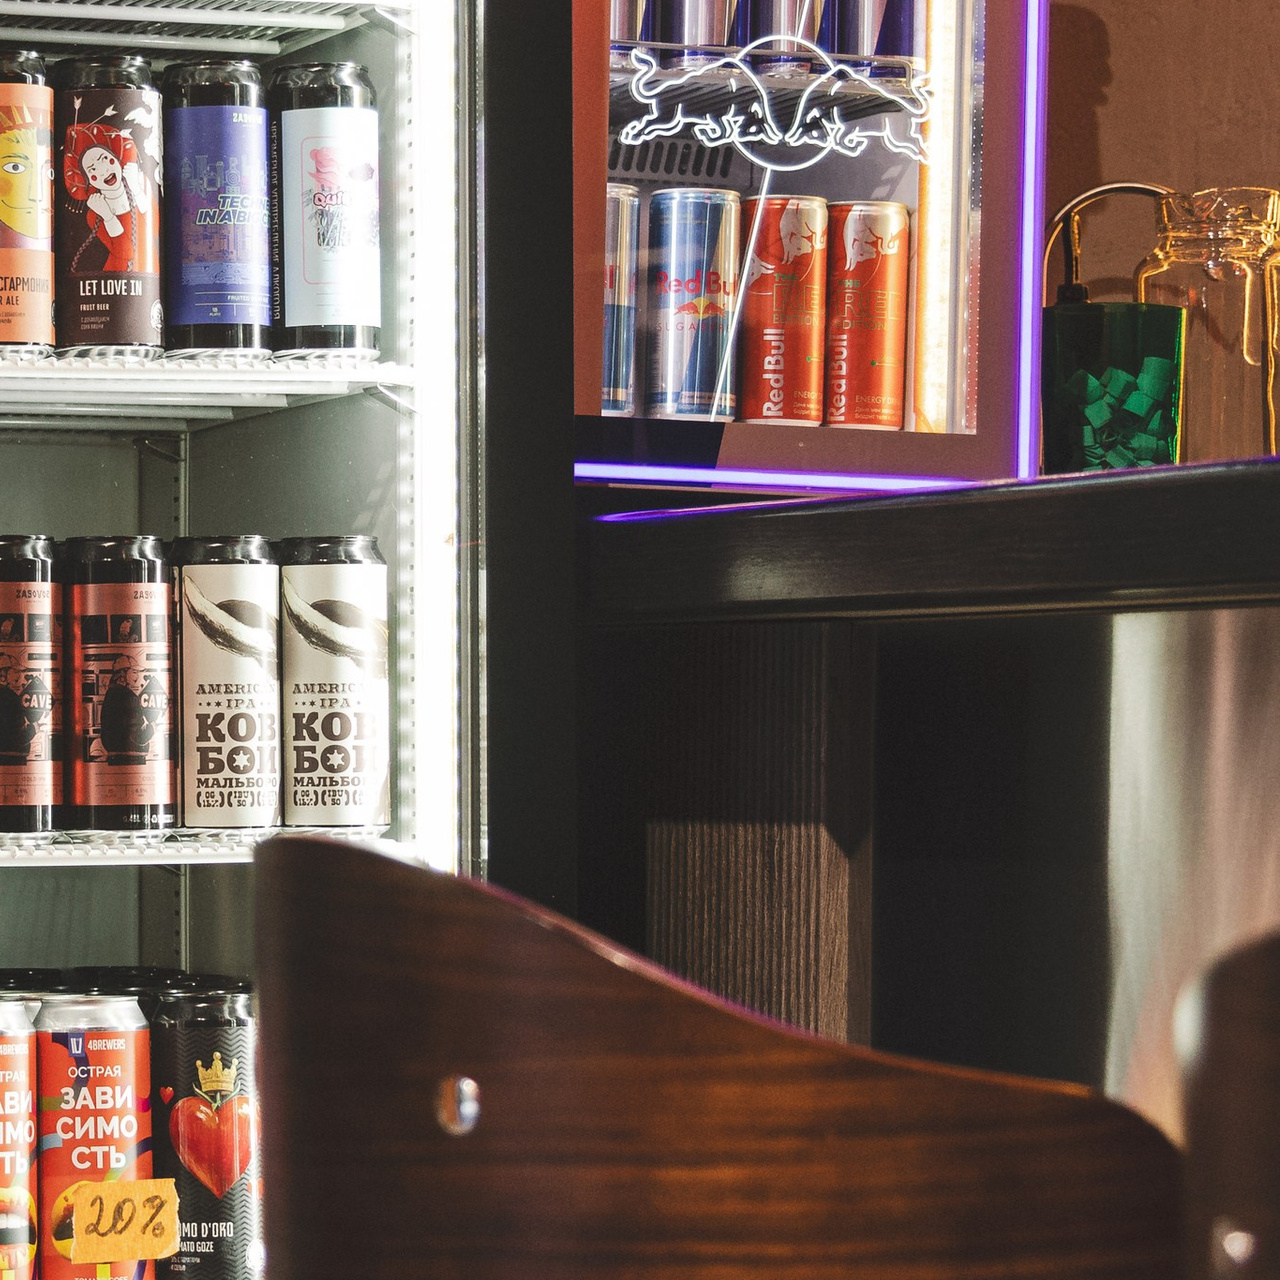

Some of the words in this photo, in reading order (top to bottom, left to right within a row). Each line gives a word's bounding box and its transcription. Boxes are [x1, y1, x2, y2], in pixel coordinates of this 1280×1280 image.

[196, 209, 218, 225] IN
[79, 280, 97, 296] LET
[101, 279, 126, 296] LOVE
[129, 280, 143, 296] IN
[656, 269, 701, 294] Red
[6, 296, 20, 306] ALE
[79, 303, 95, 312] FRUIT
[96, 303, 110, 311] BEER
[763, 328, 785, 370] Bull
[762, 373, 784, 417] Red
[22, 693, 52, 710] CAVE
[141, 693, 168, 710] CAVE
[234, 790, 250, 799] IBU
[327, 789, 344, 799] IBU
[87, 1037, 126, 1052] 4BREWERS
[67, 1065, 122, 1079] ОСТРАЯ
[60, 1084, 133, 1111] ЗАВИ
[56, 1114, 138, 1140] СИМО
[71, 1145, 126, 1170] СТЬ
[201, 1220, 234, 1238] D'ORO
[196, 1241, 215, 1253] GOZE
